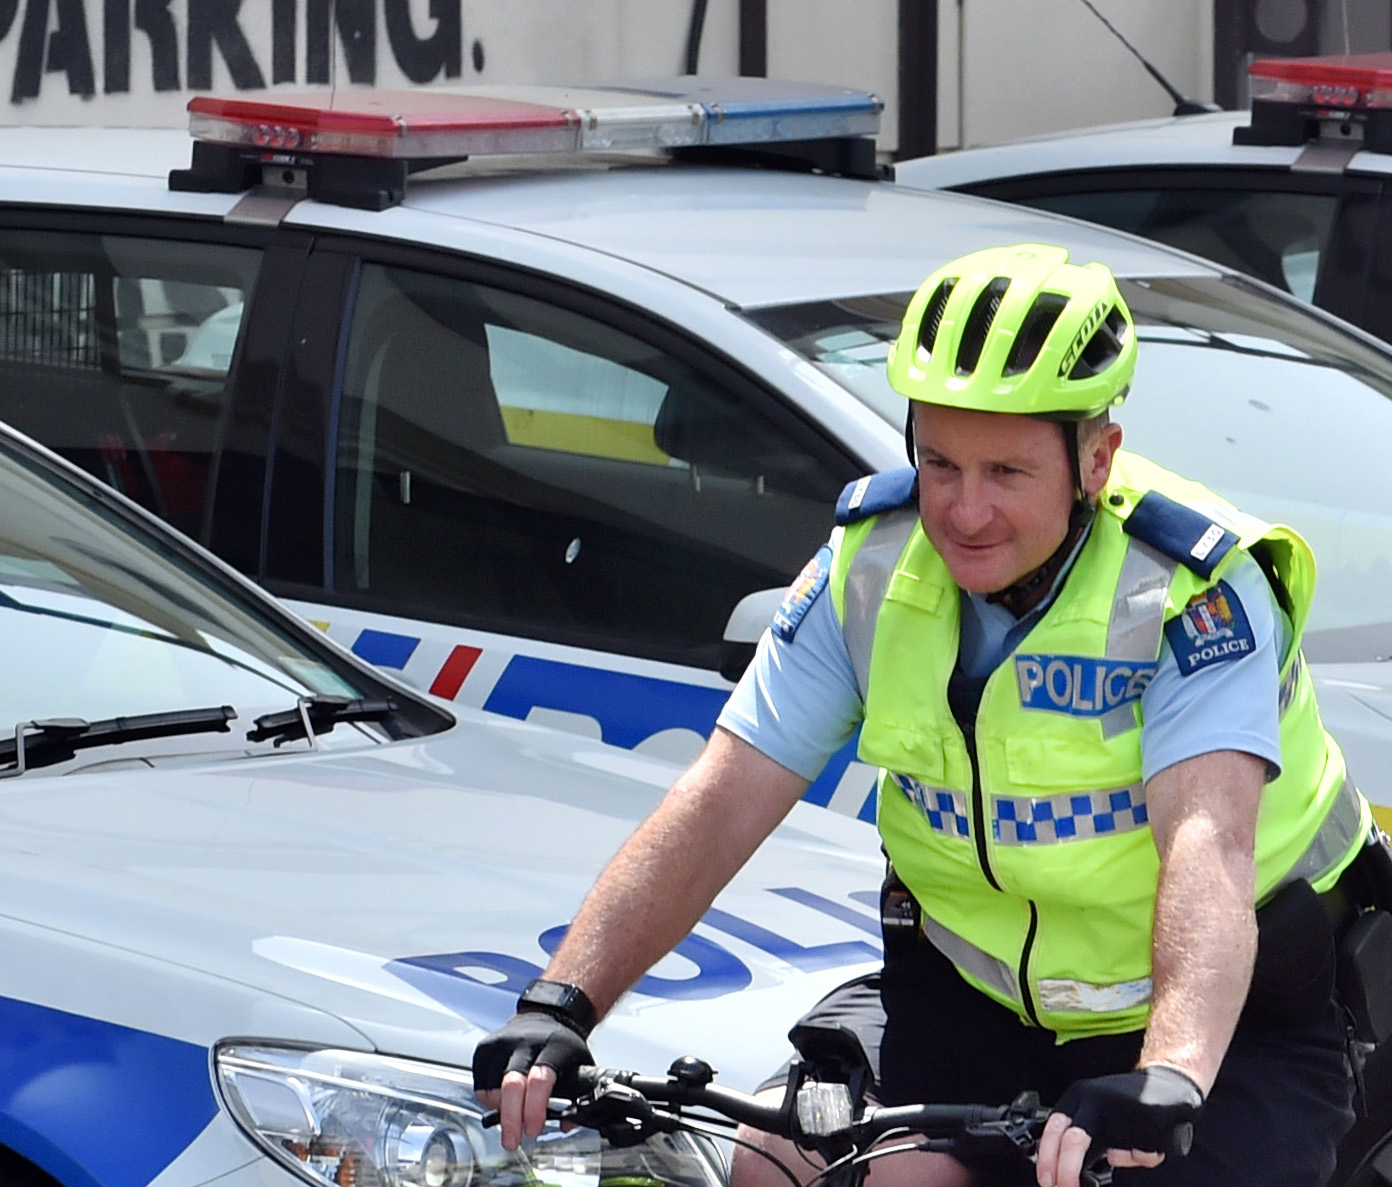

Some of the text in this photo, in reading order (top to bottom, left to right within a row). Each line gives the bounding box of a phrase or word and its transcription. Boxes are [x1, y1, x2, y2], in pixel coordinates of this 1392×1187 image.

[0, 0, 485, 102] ARKING.
[1060, 302, 1108, 375] SCOTT
[1188, 638, 1250, 667] POLICE
[1017, 660, 1157, 710] POLICE
